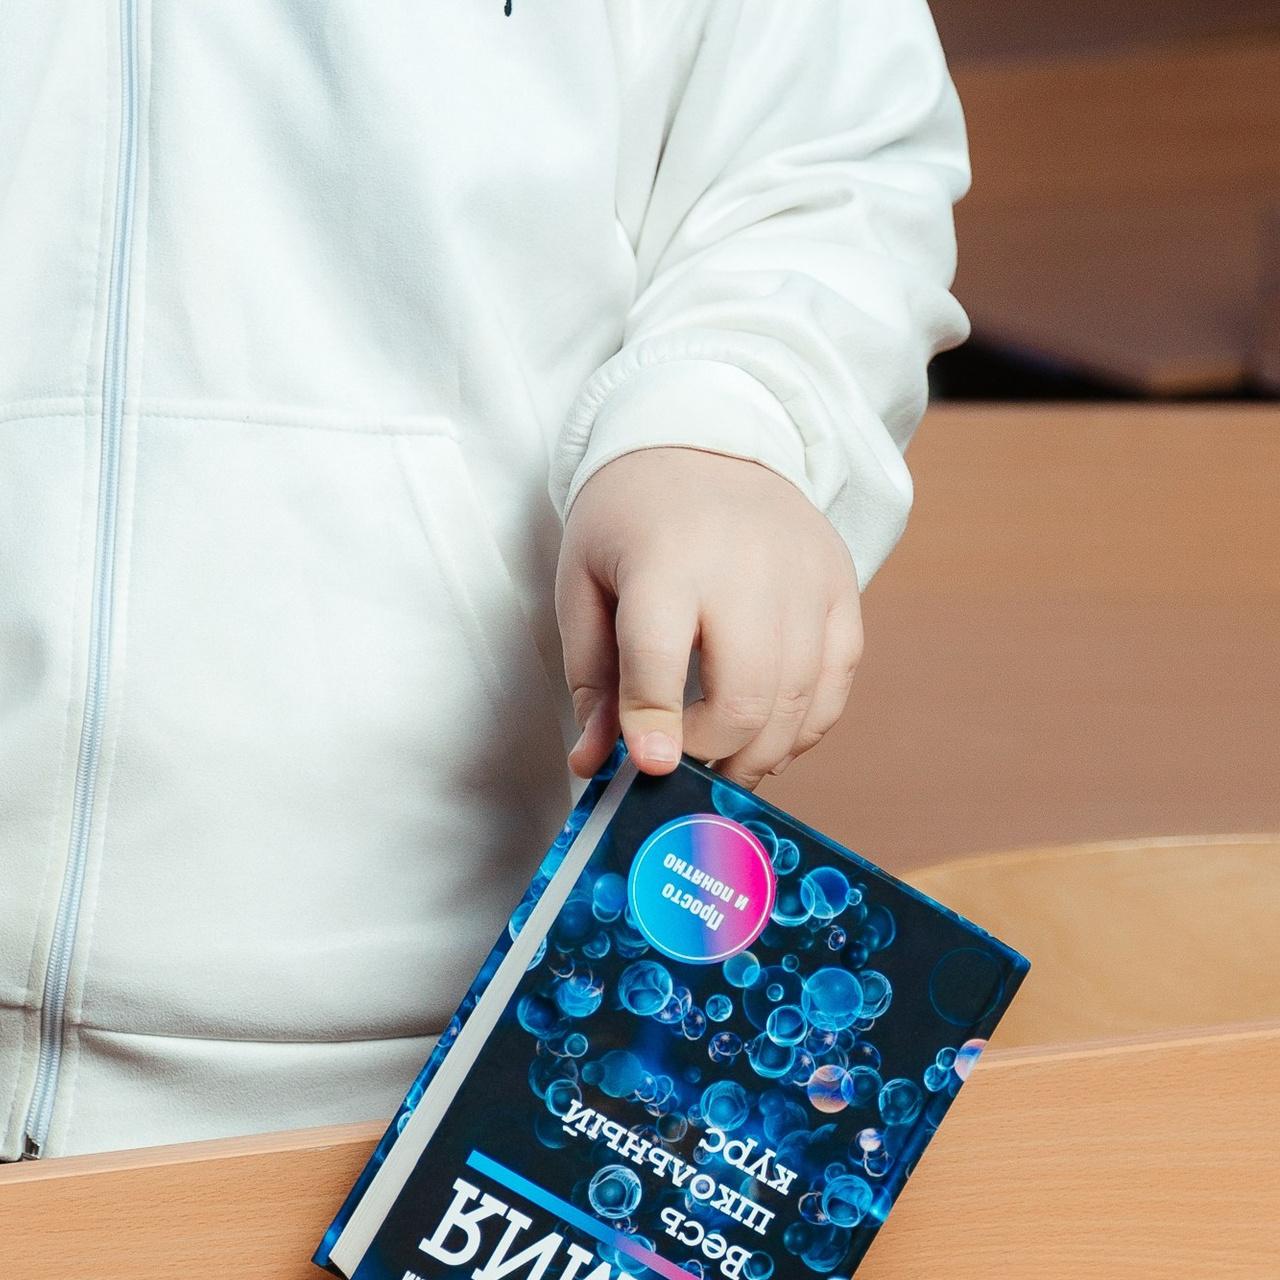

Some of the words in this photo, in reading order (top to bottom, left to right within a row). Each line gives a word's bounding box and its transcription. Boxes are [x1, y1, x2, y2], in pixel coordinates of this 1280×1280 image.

[662, 884, 725, 931] Просто
[664, 854, 735, 903] понятно
[734, 894, 749, 911] и
[561, 1098, 776, 1235] школьный
[698, 1127, 798, 1196] курс
[660, 1207, 754, 1280] Весь
